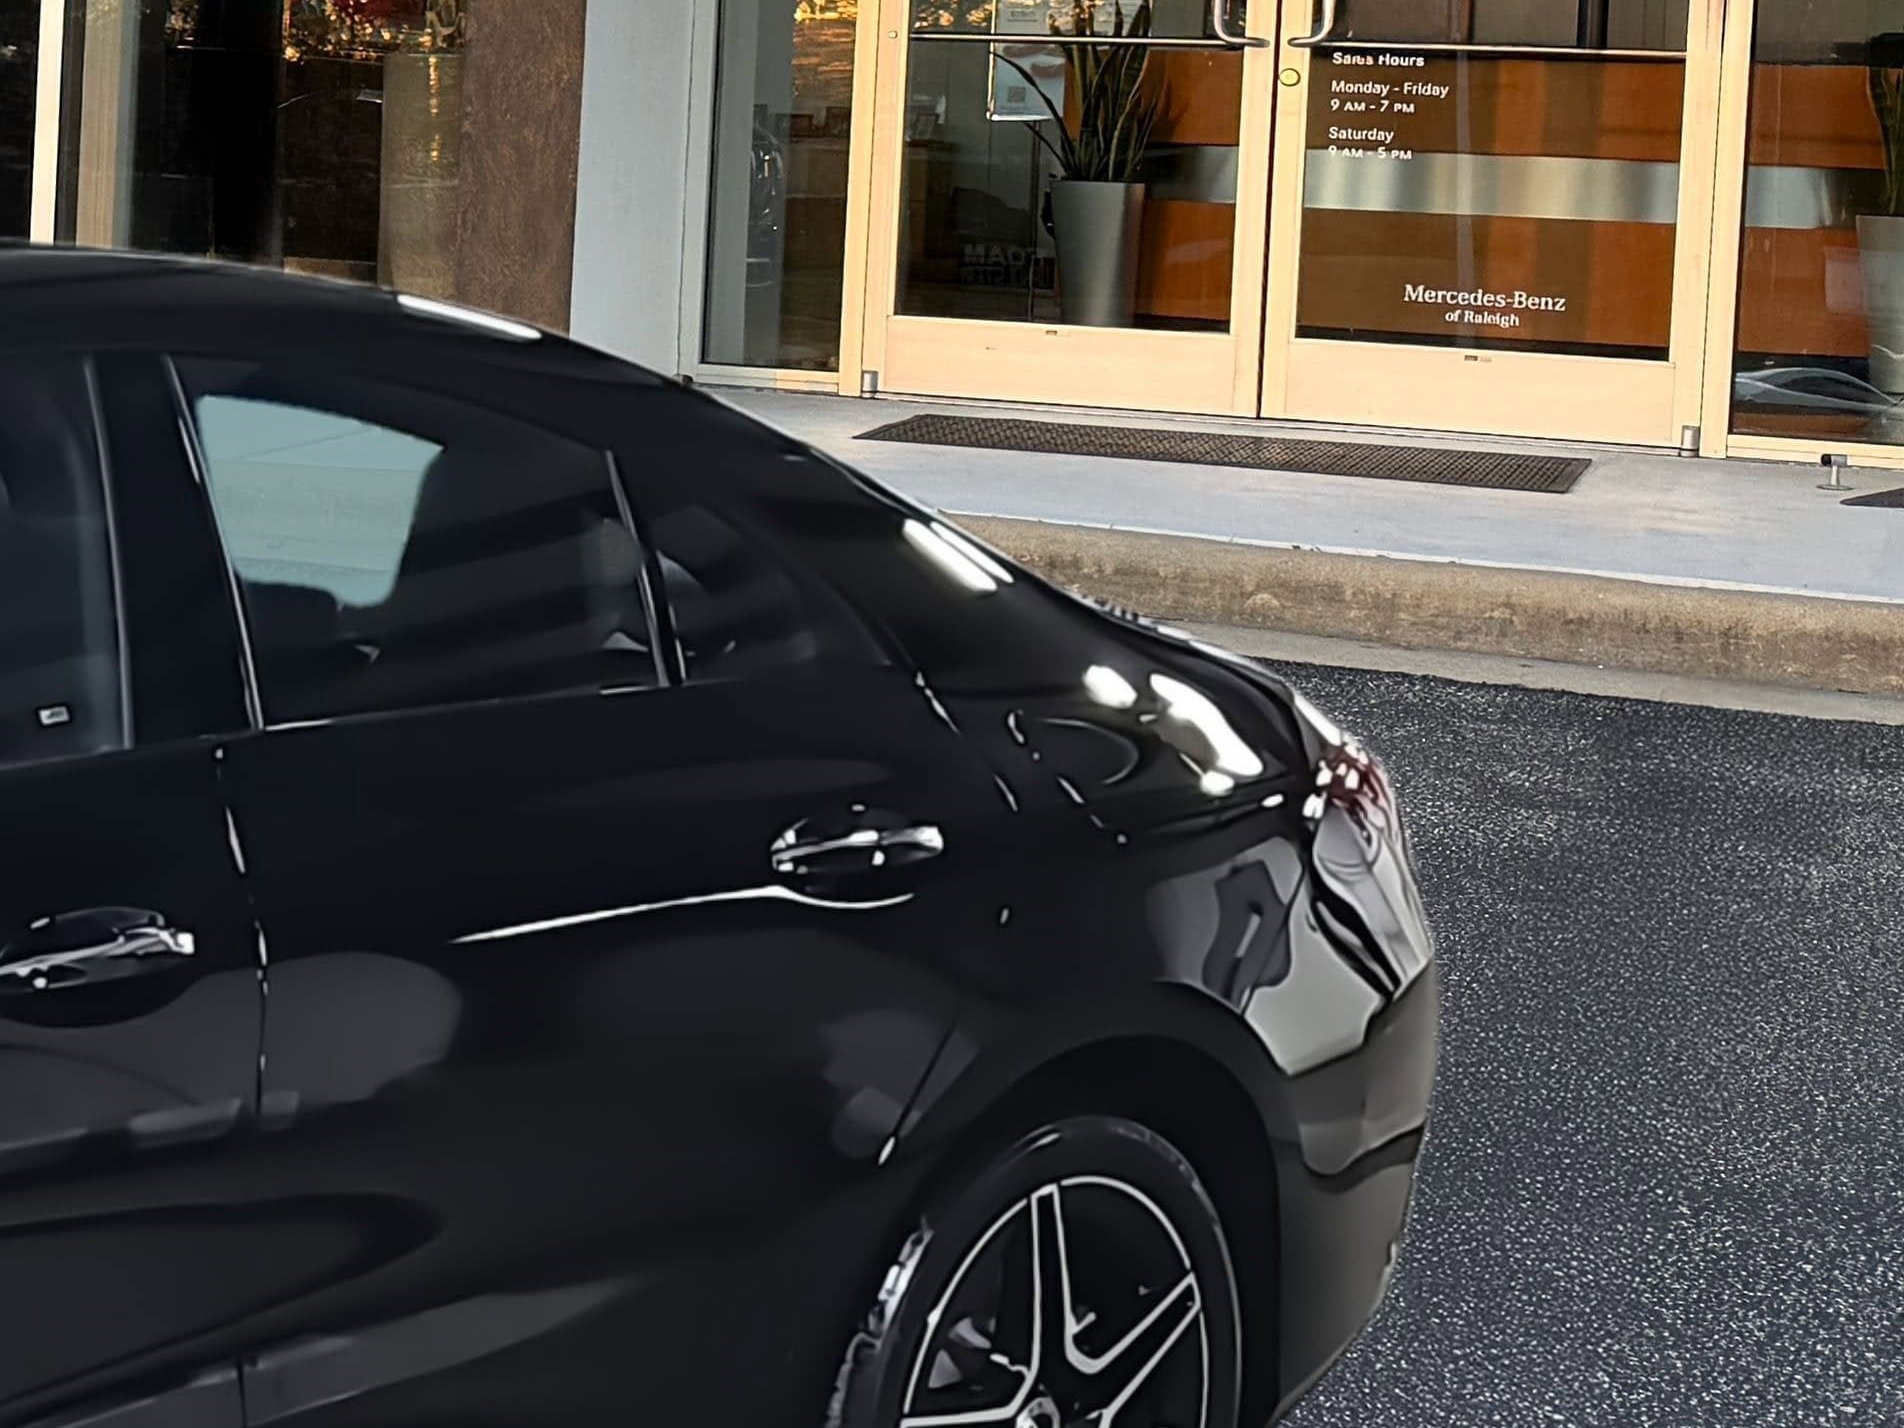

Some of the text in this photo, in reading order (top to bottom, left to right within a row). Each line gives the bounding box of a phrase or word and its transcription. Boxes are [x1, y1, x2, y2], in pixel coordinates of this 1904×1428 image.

[1378, 53, 1425, 67] Hours
[1331, 80, 1390, 97] Monday
[1403, 82, 1449, 98] Friday
[1330, 99, 1340, 111] 9
[1344, 102, 1366, 111] AM
[1380, 100, 1389, 112] 7
[1393, 103, 1415, 113] PM
[1328, 126, 1394, 144] Saturday
[1328, 145, 1337, 157] 9
[1342, 148, 1364, 158] AM
[1377, 147, 1387, 159] 5
[1391, 150, 1412, 160] PM
[1403, 284, 1567, 312] Mercedes-Benz
[1445, 310, 1520, 328] of Raleigh
